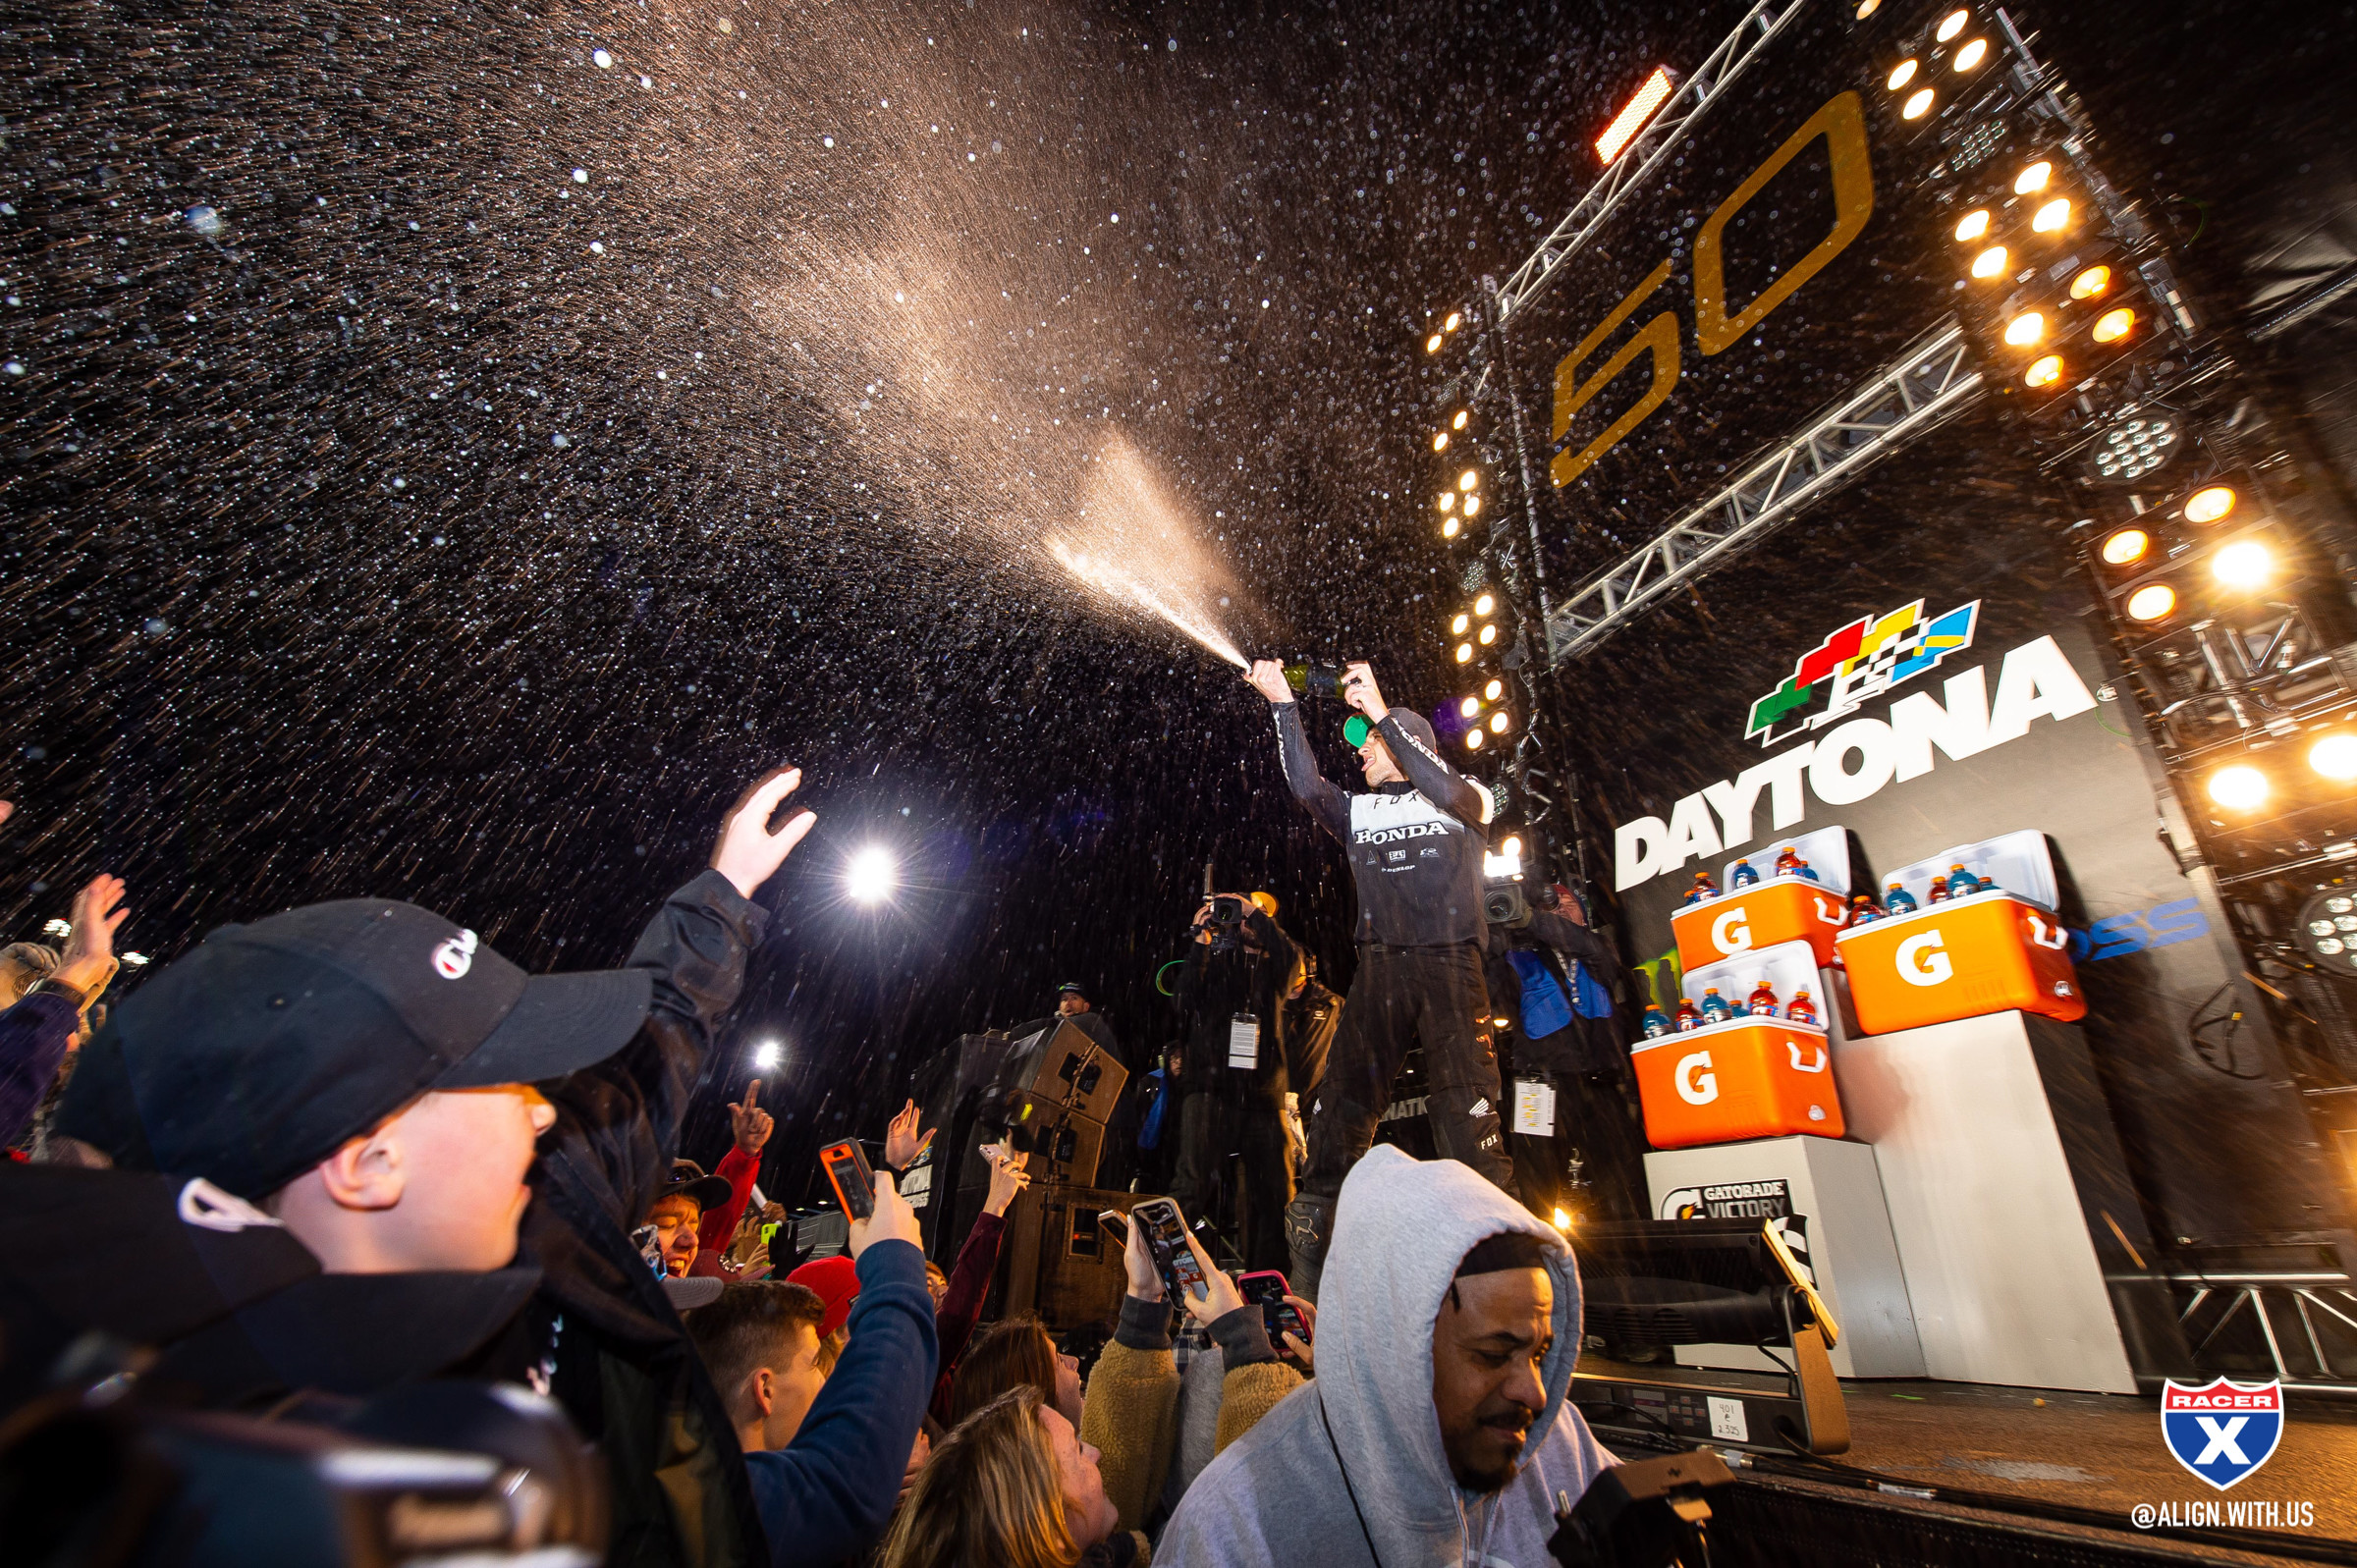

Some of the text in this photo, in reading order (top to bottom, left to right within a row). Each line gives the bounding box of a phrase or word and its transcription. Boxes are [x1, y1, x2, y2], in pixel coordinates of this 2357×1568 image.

[1550, 89, 1874, 488] 50
[1391, 717, 1449, 775] HONDA
[1615, 634, 2098, 892] DAYTONA
[1374, 791, 1420, 810] FOX
[1355, 821, 1450, 845] HONDA
[1386, 864, 1416, 873] DUNLOP
[1712, 907, 1752, 955] G
[1895, 930, 1954, 987] G
[1674, 1051, 1720, 1106] G
[1480, 1133, 1499, 1151] FOX
[1704, 1181, 1785, 1201] GATORADE
[1705, 1198, 1786, 1218] VICTORY
